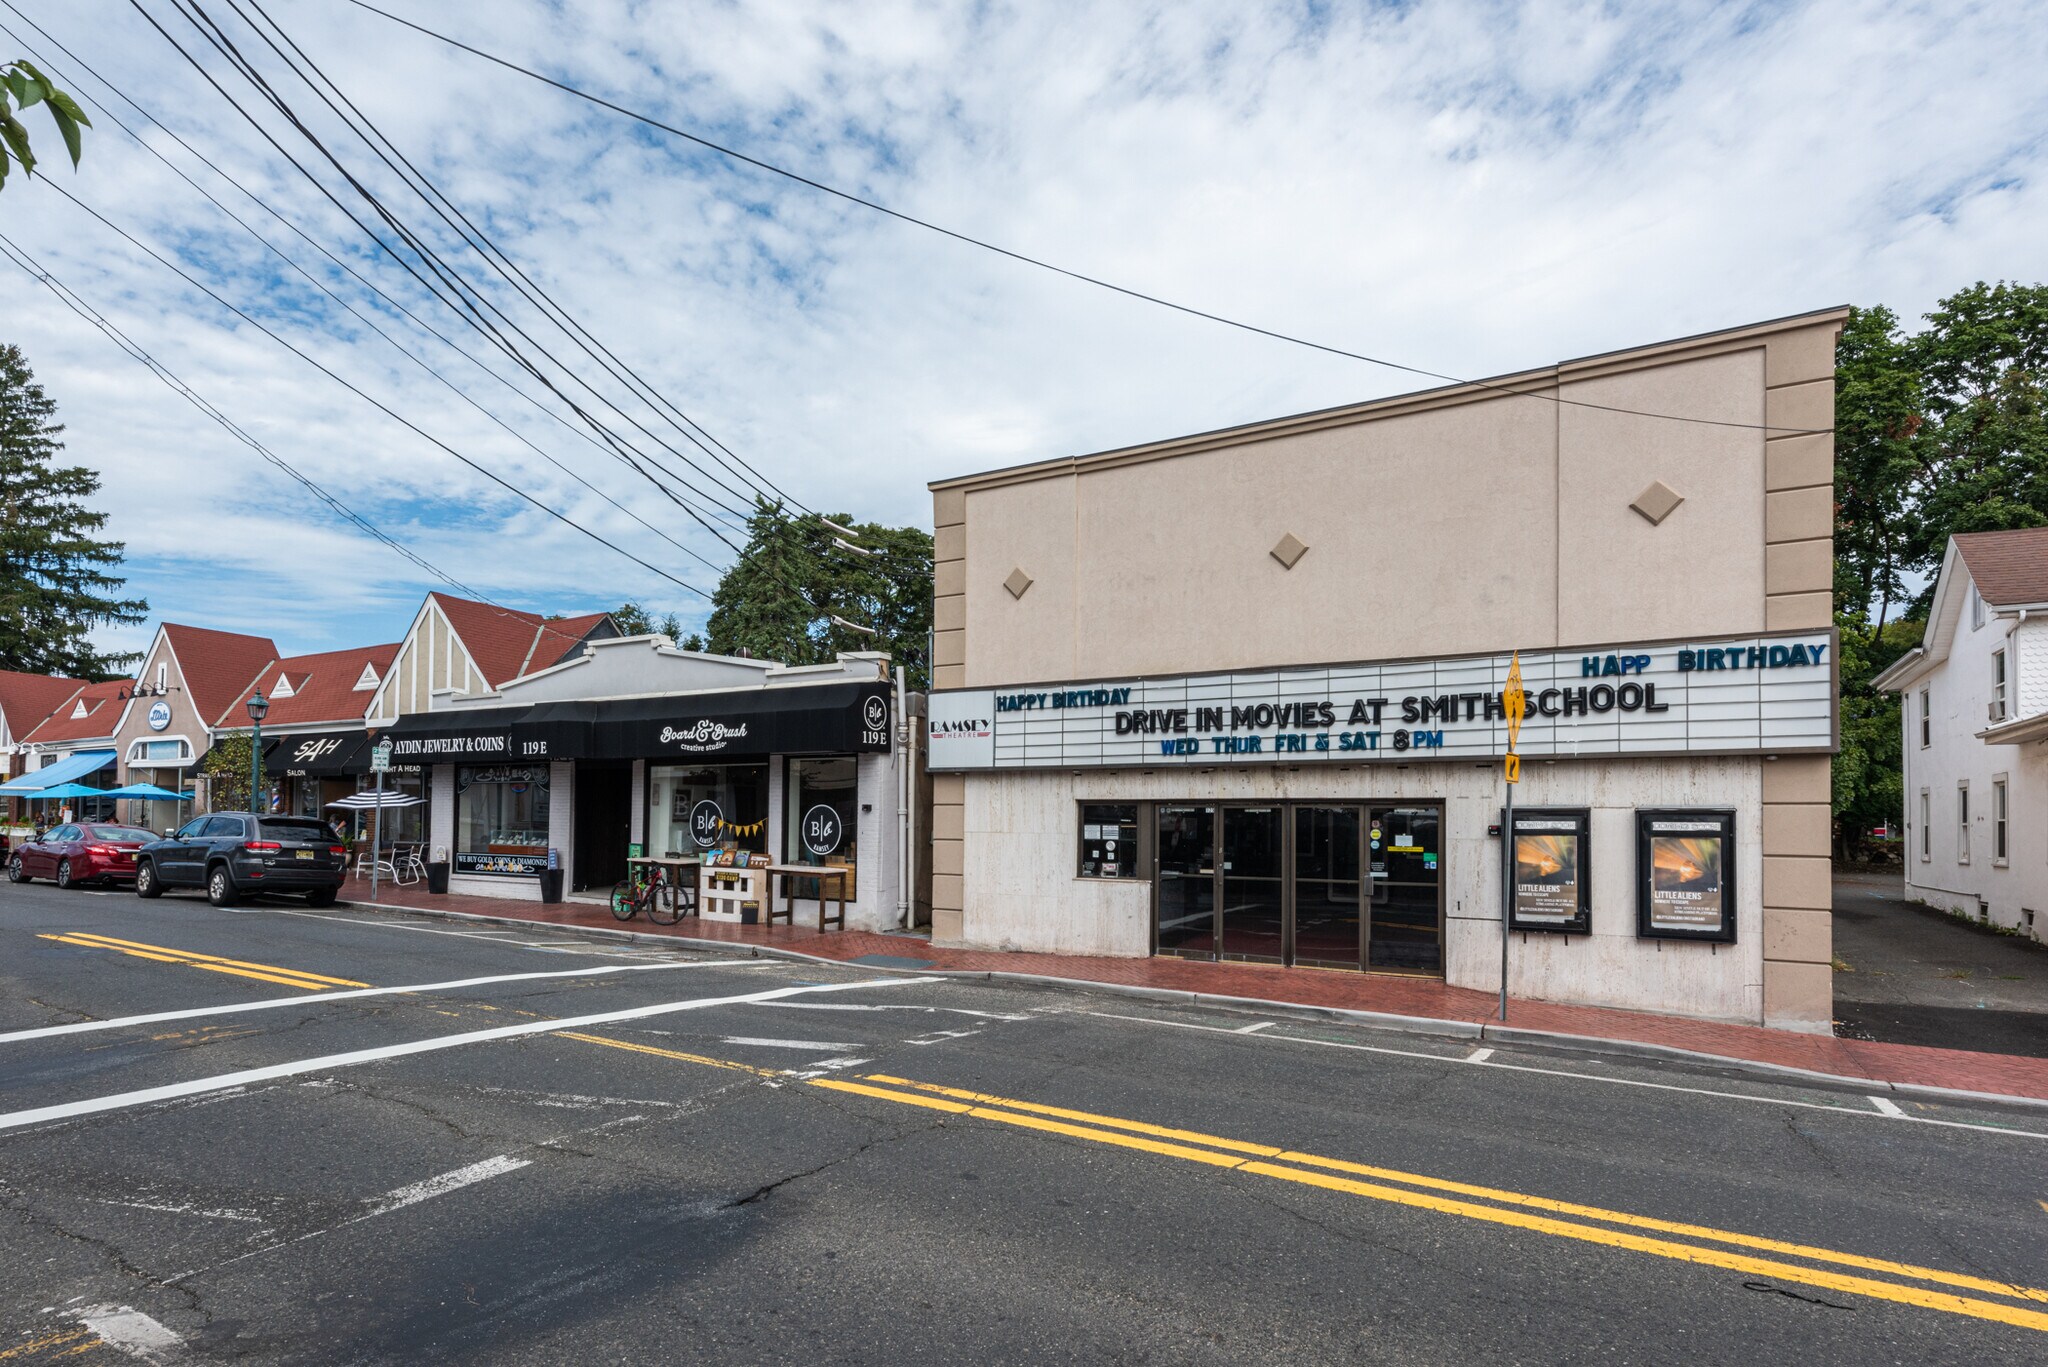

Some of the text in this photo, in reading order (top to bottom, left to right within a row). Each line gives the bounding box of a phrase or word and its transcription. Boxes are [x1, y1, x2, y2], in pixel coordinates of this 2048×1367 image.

[1582, 643, 1827, 678] HAPP BIRTHDAY
[996, 687, 1131, 712] HAPPY BIRTHDAY
[1115, 708, 1188, 735] DRIVE
[1196, 706, 1223, 732] IN
[1231, 701, 1336, 731] MOVIES
[1348, 698, 1388, 726] AT
[1401, 692, 1506, 724] SMITH
[660, 719, 748, 743] Board & Brush
[930, 719, 991, 733] RAMSEY
[943, 731, 977, 739] THEATRE
[394, 736, 504, 754] AYDIN JEWELRY & COINS
[522, 741, 548, 755] 119 E
[681, 741, 726, 751] creative studio
[1161, 729, 1444, 756] WED THUR FRI & SAT 8 PM
[294, 738, 343, 762] SAH
[286, 769, 306, 777] SALON
[397, 764, 404, 772] A
[467, 855, 477, 863] BUY
[517, 857, 548, 866] DIAMONDS
[1518, 884, 1561, 893] LITTLE ALIENS
[1654, 890, 1702, 900] LITTLE ALIENS
